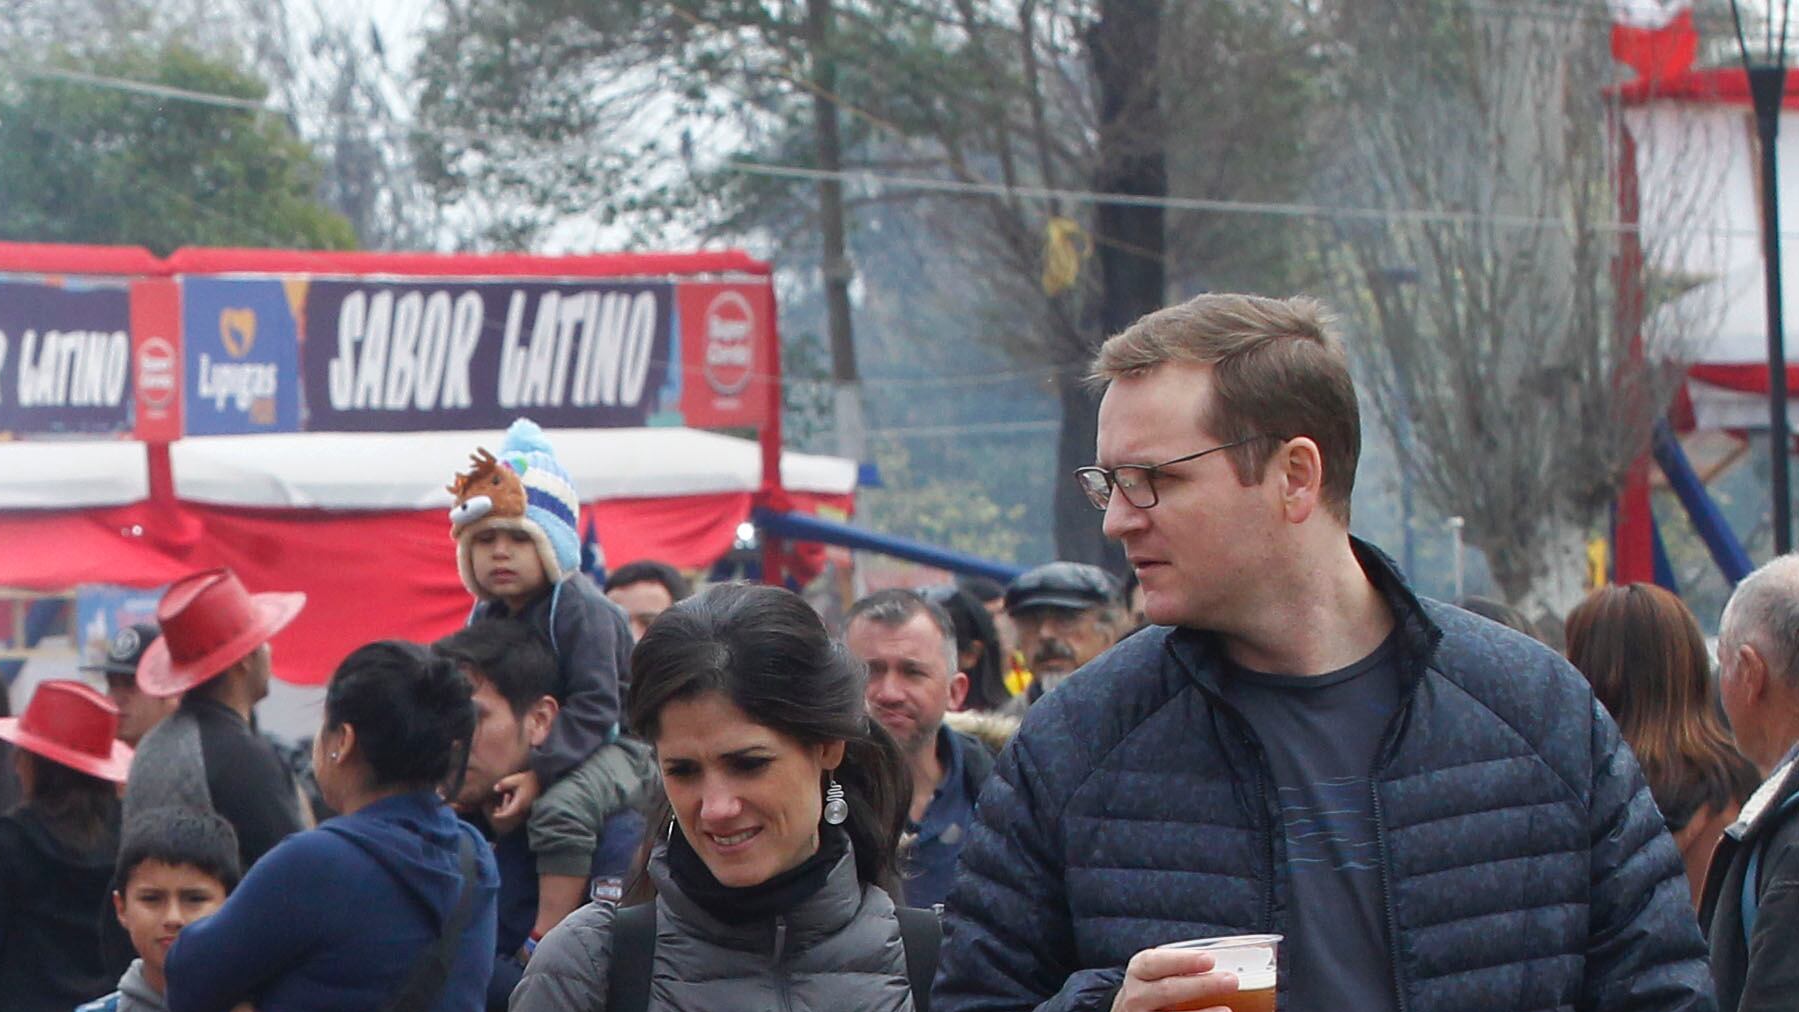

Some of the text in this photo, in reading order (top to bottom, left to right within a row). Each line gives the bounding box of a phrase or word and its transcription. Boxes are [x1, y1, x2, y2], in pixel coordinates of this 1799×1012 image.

[17, 328, 129, 407] LATINO
[329, 290, 485, 410] SABOR
[498, 290, 657, 409] LATINO
